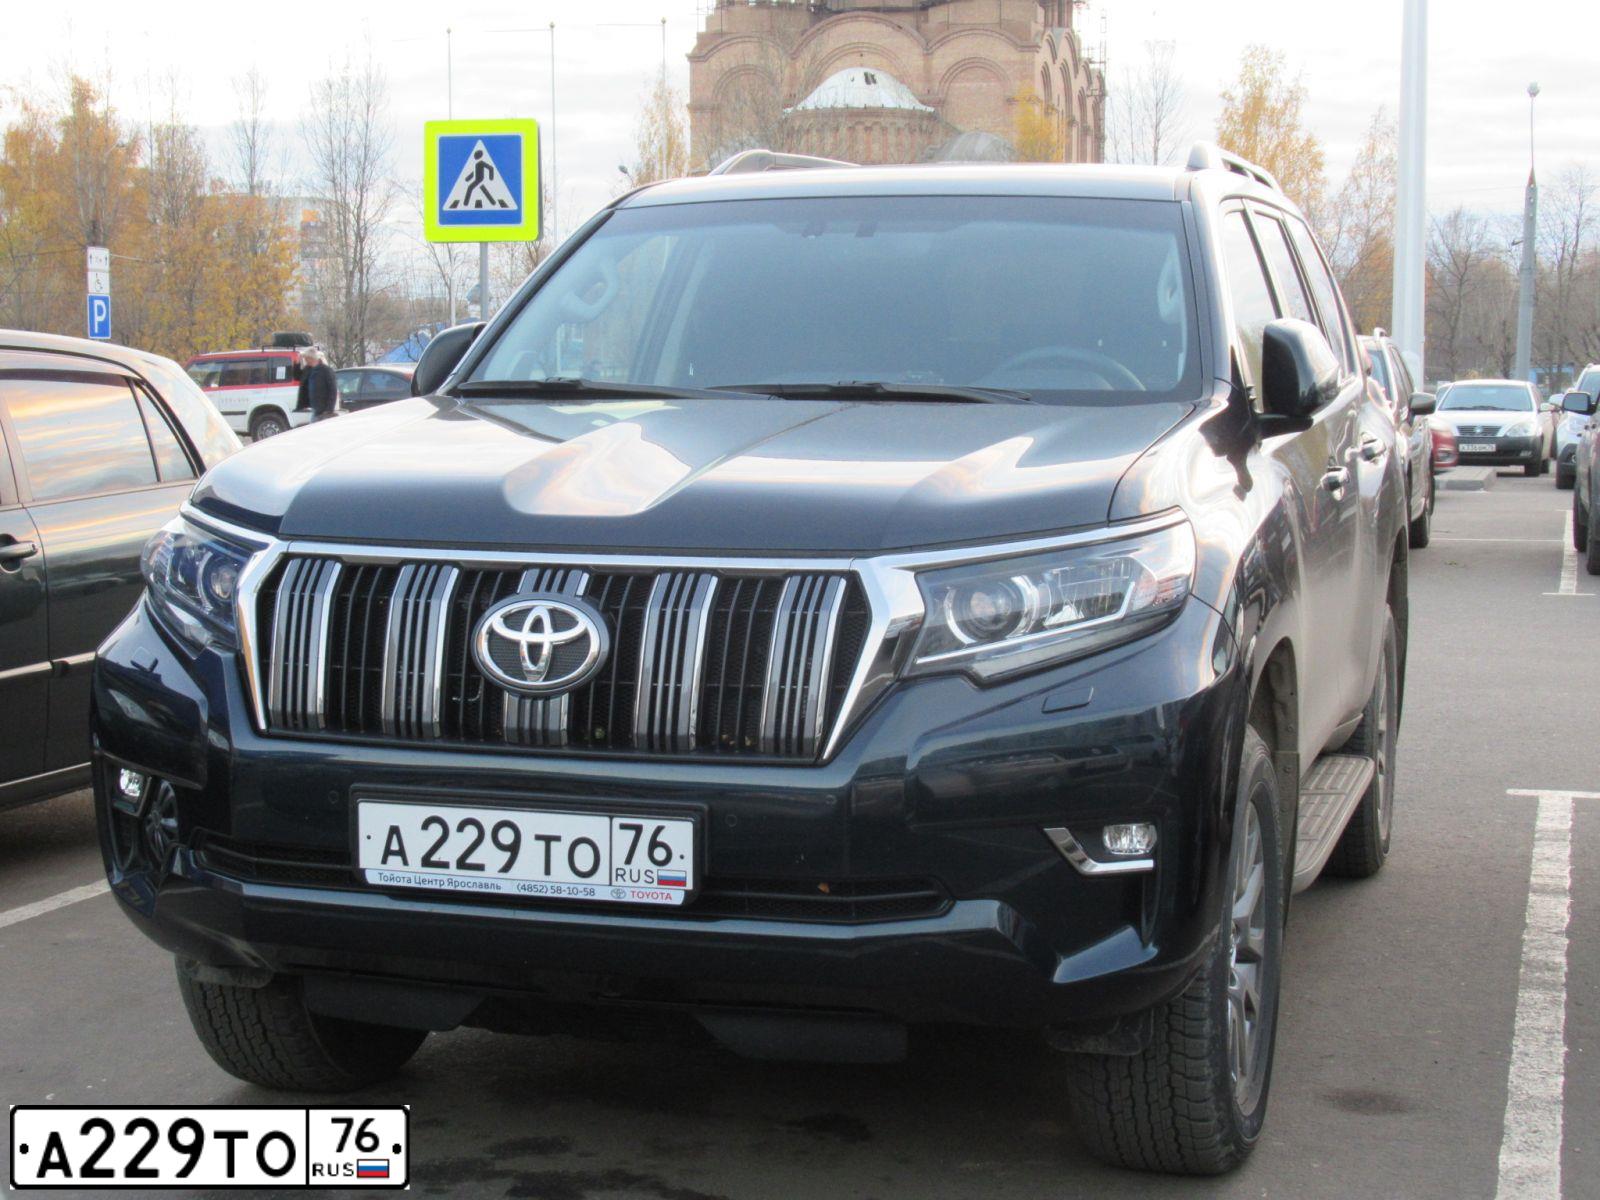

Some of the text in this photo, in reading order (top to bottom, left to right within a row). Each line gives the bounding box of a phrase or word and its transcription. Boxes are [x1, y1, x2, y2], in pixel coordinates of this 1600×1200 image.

[93, 299, 107, 334] P
[619, 823, 673, 867] 76
[378, 872, 596, 897] Тойота Центр Ярославль (4852) 58-10-58
[615, 867, 655, 885] RUS
[630, 890, 673, 901] TOYOTA
